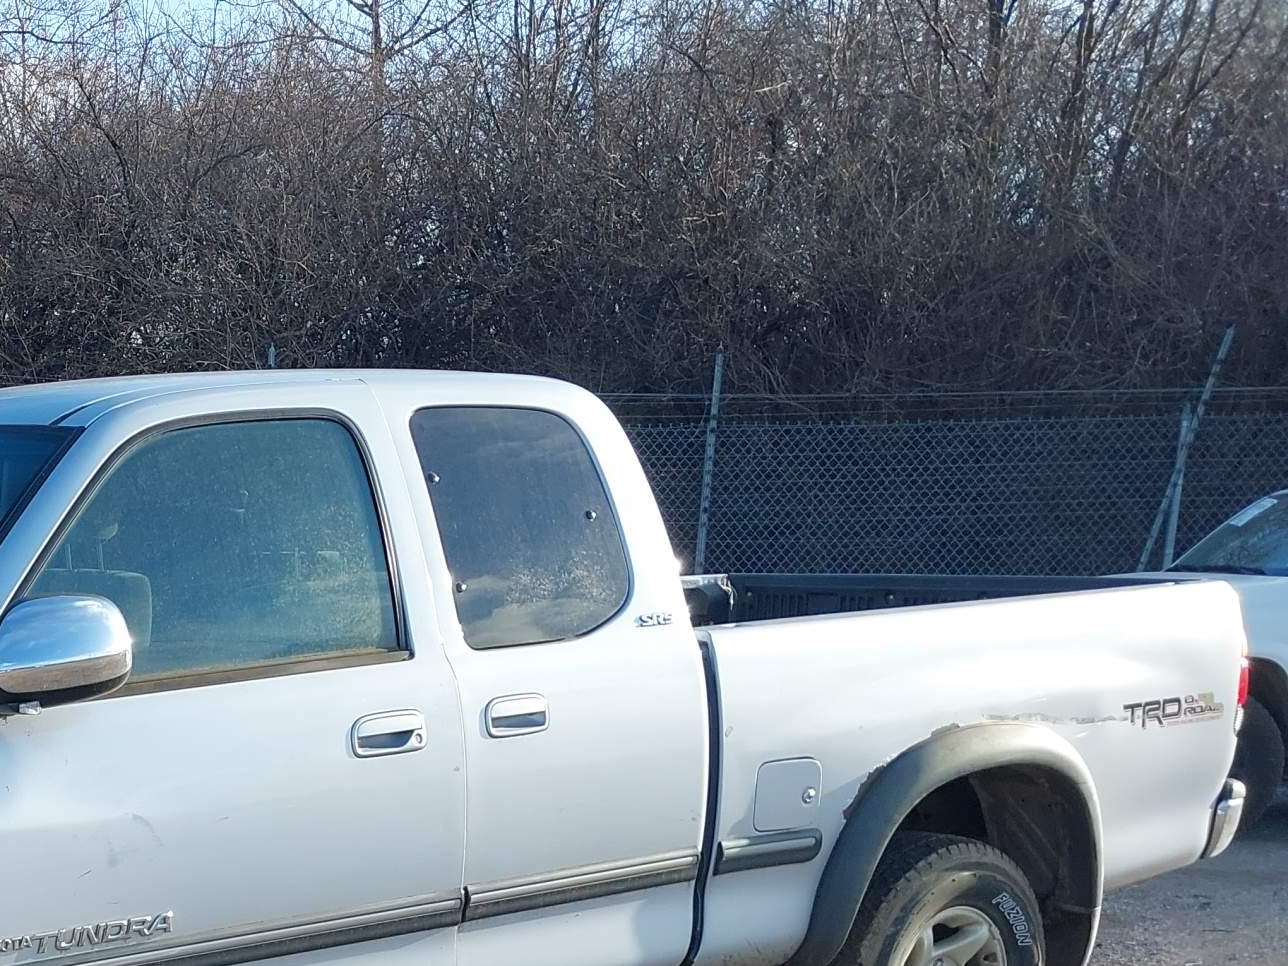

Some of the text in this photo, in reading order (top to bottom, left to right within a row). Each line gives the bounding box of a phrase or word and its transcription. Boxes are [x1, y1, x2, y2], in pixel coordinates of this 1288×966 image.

[1123, 697, 1181, 728] TRD
[33, 910, 174, 953] TUNDRA
[992, 892, 1032, 946] FUZION
